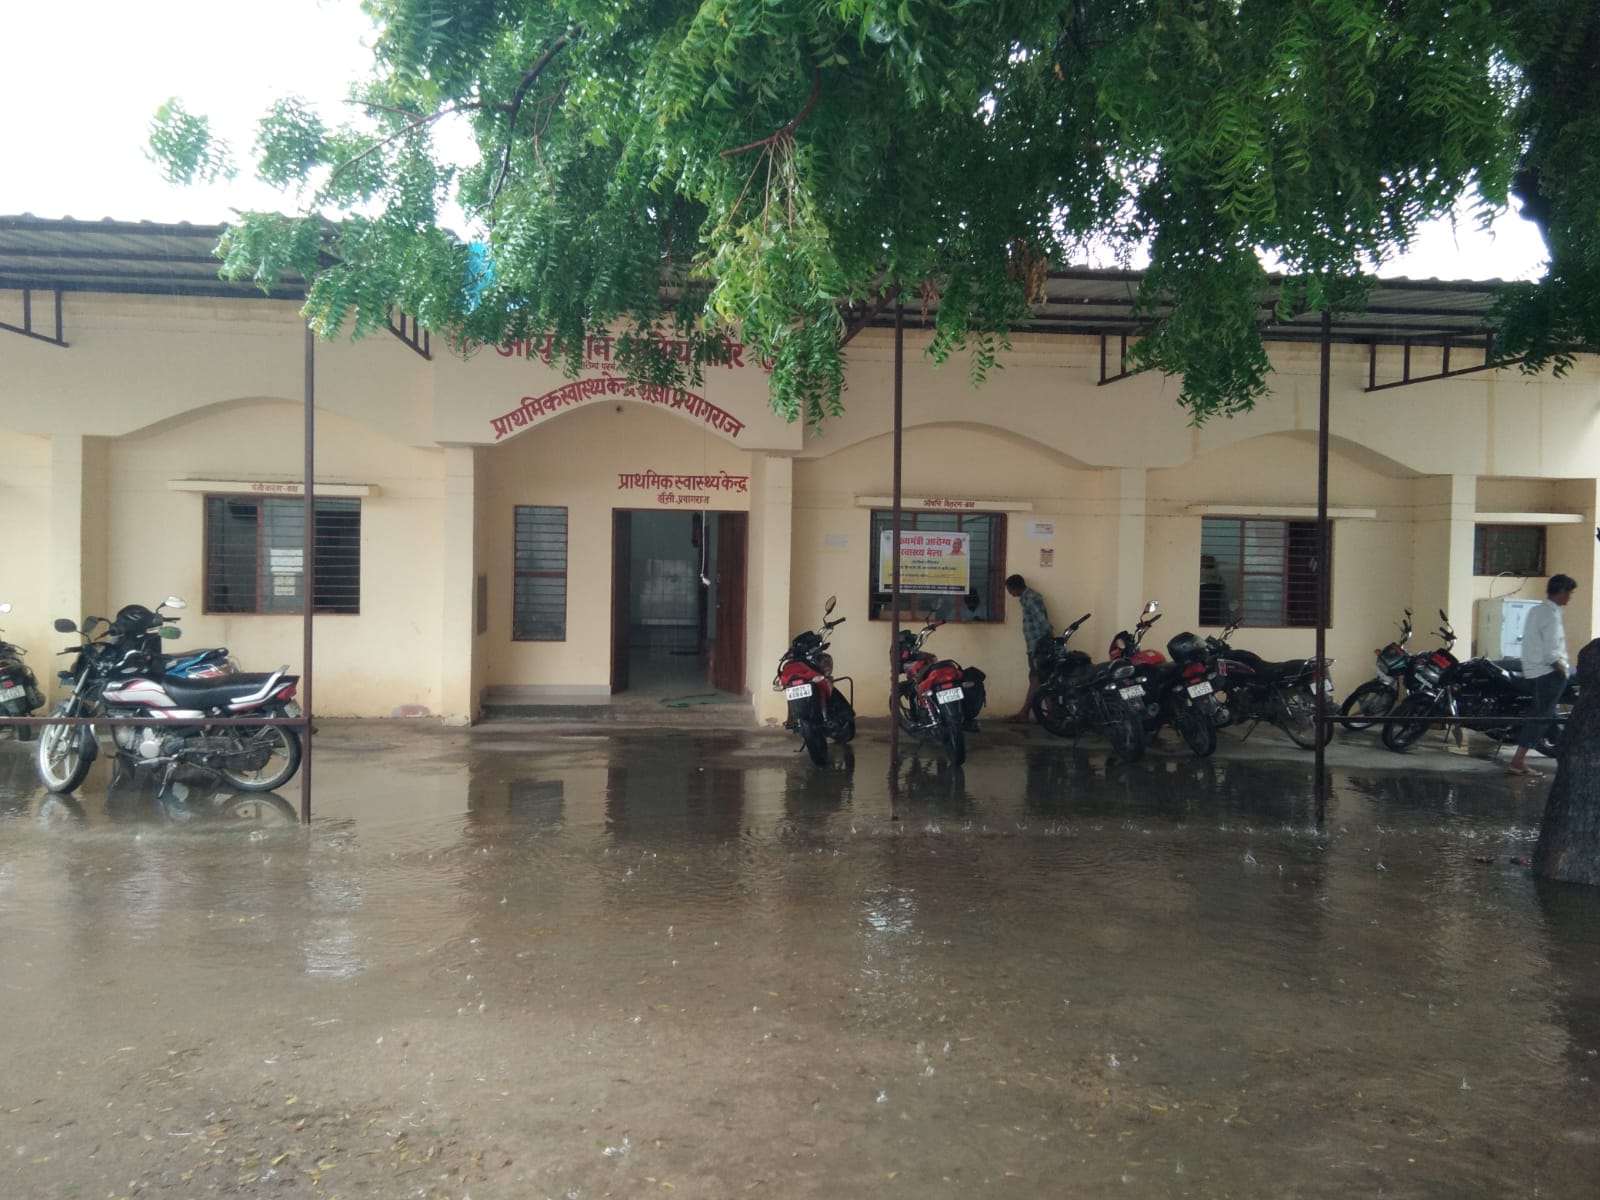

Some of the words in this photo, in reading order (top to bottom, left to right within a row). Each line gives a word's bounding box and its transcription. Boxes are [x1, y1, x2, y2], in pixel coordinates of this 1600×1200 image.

[490, 397, 562, 440] प्राथमिक
[559, 377, 606, 405] स्वास्थ्य
[671, 388, 747, 438] प्रयागराज
[618, 469, 673, 490] प्राथमिक
[674, 474, 722, 491] स्वास्थ्य
[720, 470, 749, 493] केन्द्र
